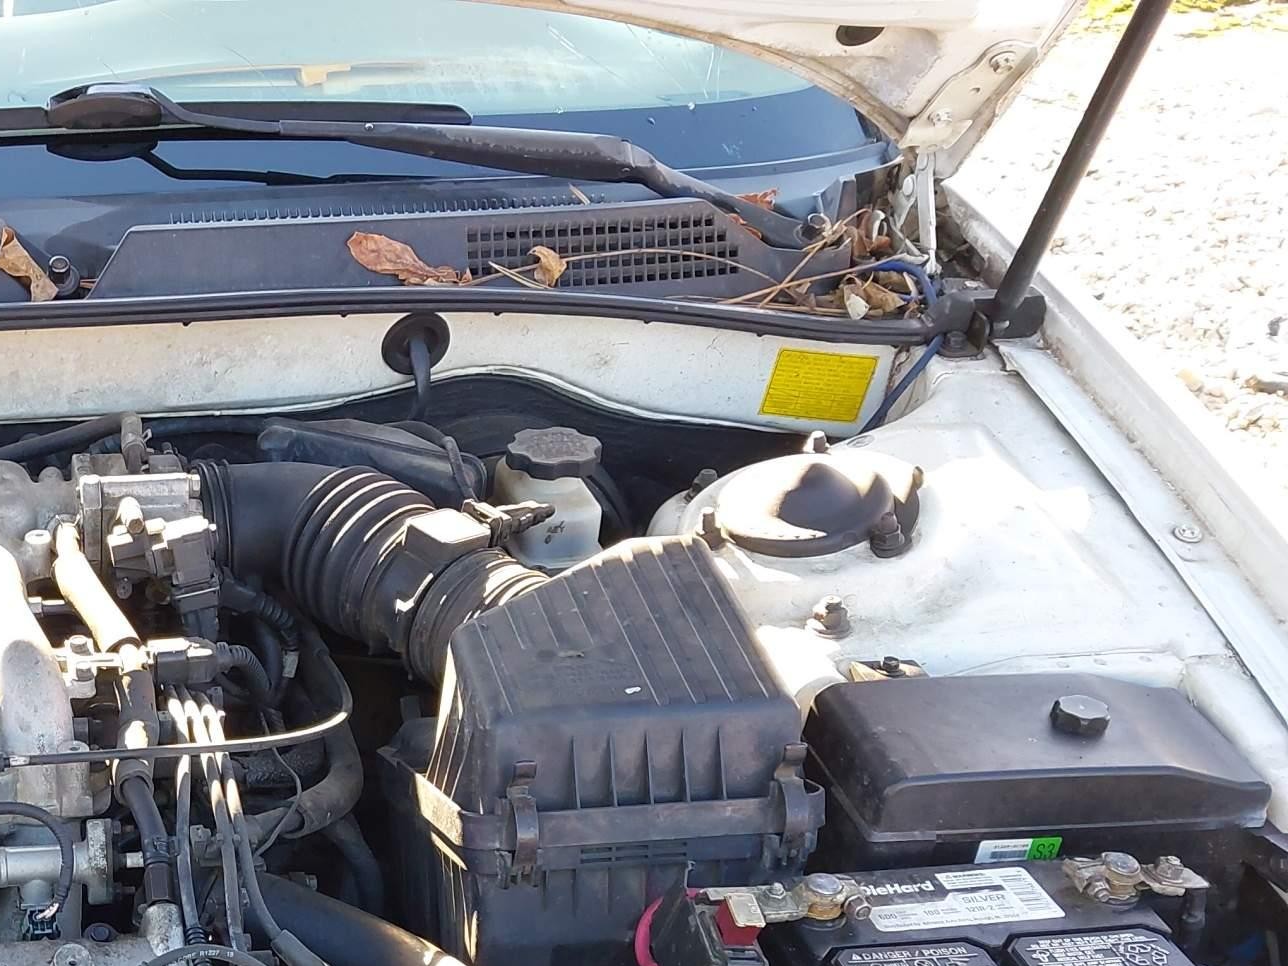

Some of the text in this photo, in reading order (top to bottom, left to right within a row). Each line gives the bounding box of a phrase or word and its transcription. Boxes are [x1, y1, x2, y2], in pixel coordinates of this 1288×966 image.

[961, 893, 1006, 904] SILVER
[862, 950, 910, 960] DANGER
[922, 946, 967, 957] POISON
